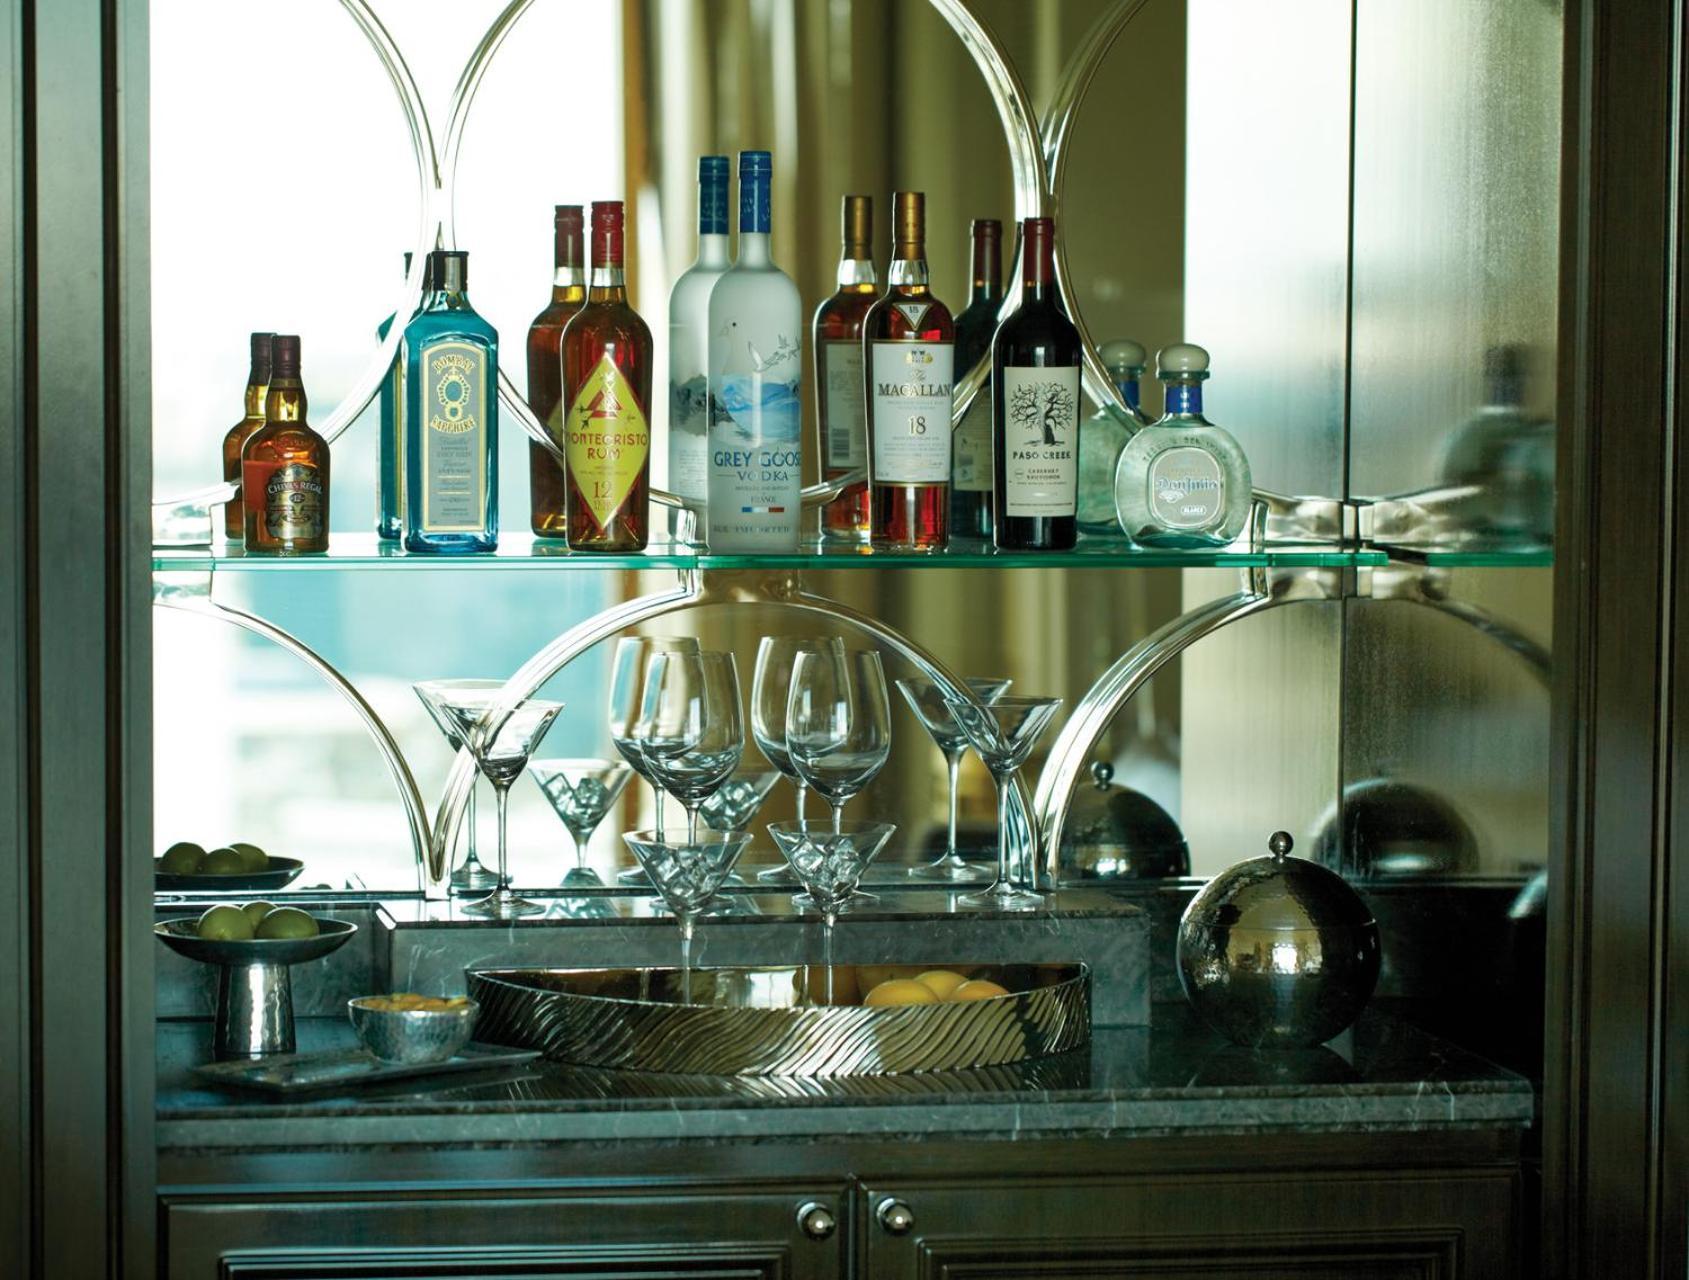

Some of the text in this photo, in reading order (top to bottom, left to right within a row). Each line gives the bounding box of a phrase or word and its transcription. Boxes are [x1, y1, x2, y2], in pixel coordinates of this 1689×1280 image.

[878, 384, 952, 397] MACALLAN
[909, 416, 926, 435] 18
[714, 451, 752, 467] GREY
[759, 451, 801, 467] GOOS
[1012, 451, 1072, 460] PASO CREEK
[737, 471, 789, 481] VODKA
[593, 481, 613, 499] 12
